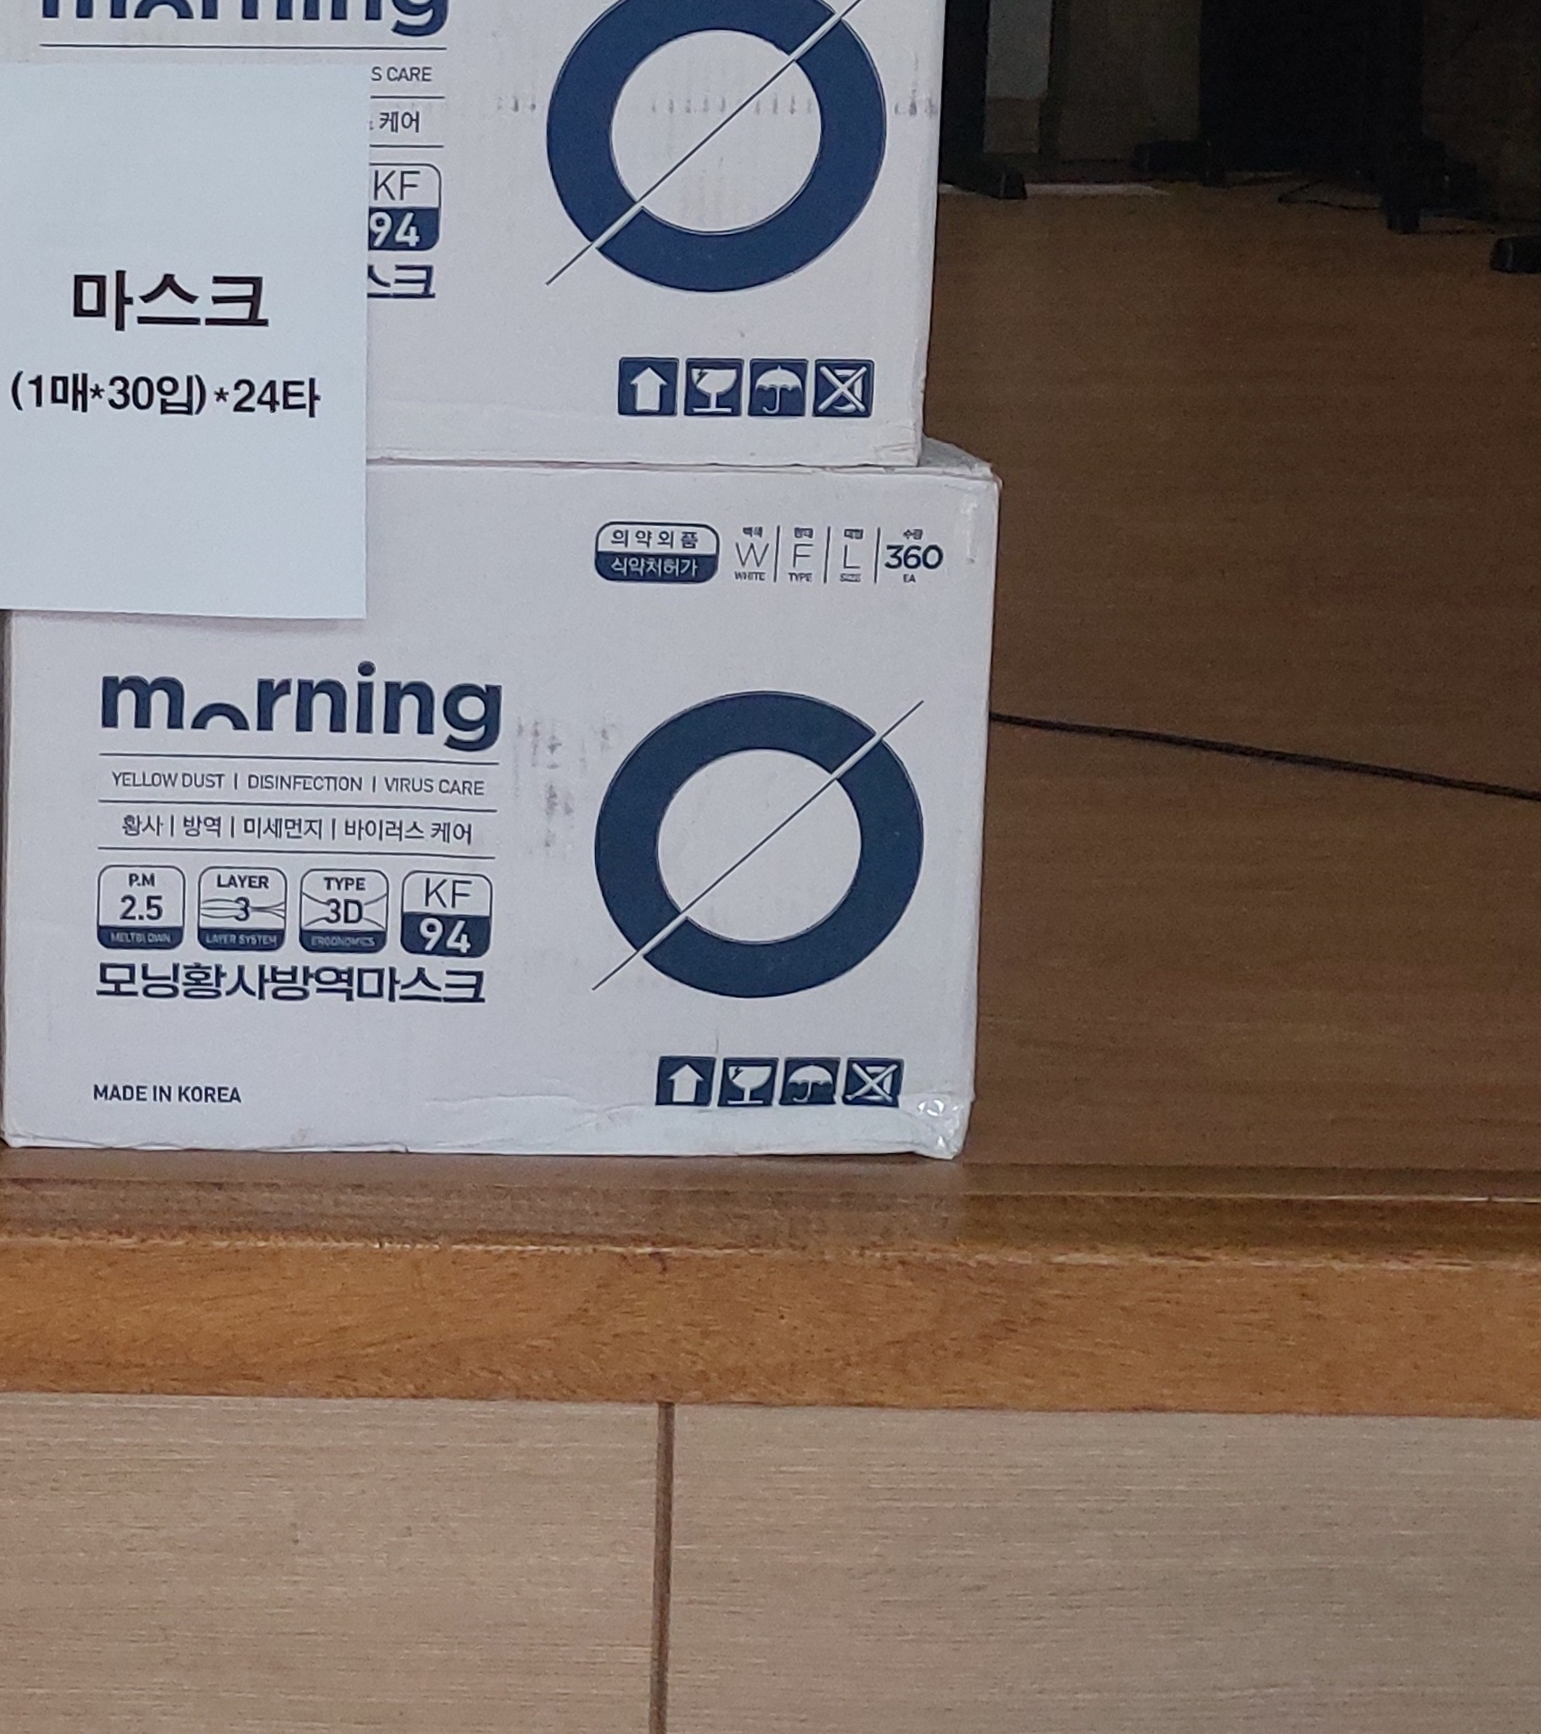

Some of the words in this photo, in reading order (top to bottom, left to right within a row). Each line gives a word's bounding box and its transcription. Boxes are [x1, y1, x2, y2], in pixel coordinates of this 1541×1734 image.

[386, 66, 433, 82] CARE
[378, 110, 421, 133] 케어
[373, 169, 421, 201] KF
[369, 211, 421, 247] 94
[71, 269, 271, 334] 마스크
[734, 541, 770, 568] W
[792, 542, 814, 569] F
[842, 544, 861, 569] L
[883, 543, 944, 570] 360
[734, 570, 766, 582] WHITE
[787, 571, 813, 583] TYPE
[902, 573, 916, 584] EA
[100, 660, 504, 750] morning
[111, 771, 180, 790] YELLOW
[181, 773, 226, 790] DUST
[247, 774, 363, 793] DISINFECTION
[383, 776, 435, 794] VIRUS
[438, 778, 486, 797] CARE
[121, 813, 164, 838] 황사
[182, 815, 222, 839] 방역
[243, 816, 323, 841] 미세먼지
[343, 819, 425, 843] 바이러스
[430, 821, 473, 846] 케어
[128, 873, 156, 888] P.M
[216, 874, 270, 890] LAYER
[323, 876, 366, 892] TYPE
[423, 877, 473, 909] KF
[118, 894, 164, 922] 2.5
[234, 896, 251, 922] 3
[325, 897, 364, 925] 3D
[418, 917, 472, 954] 94
[95, 961, 487, 1004] 모닝황사방역마스크
[92, 1083, 147, 1104] MADE
[152, 1084, 172, 1104] IN
[176, 1084, 243, 1105] KOREA
